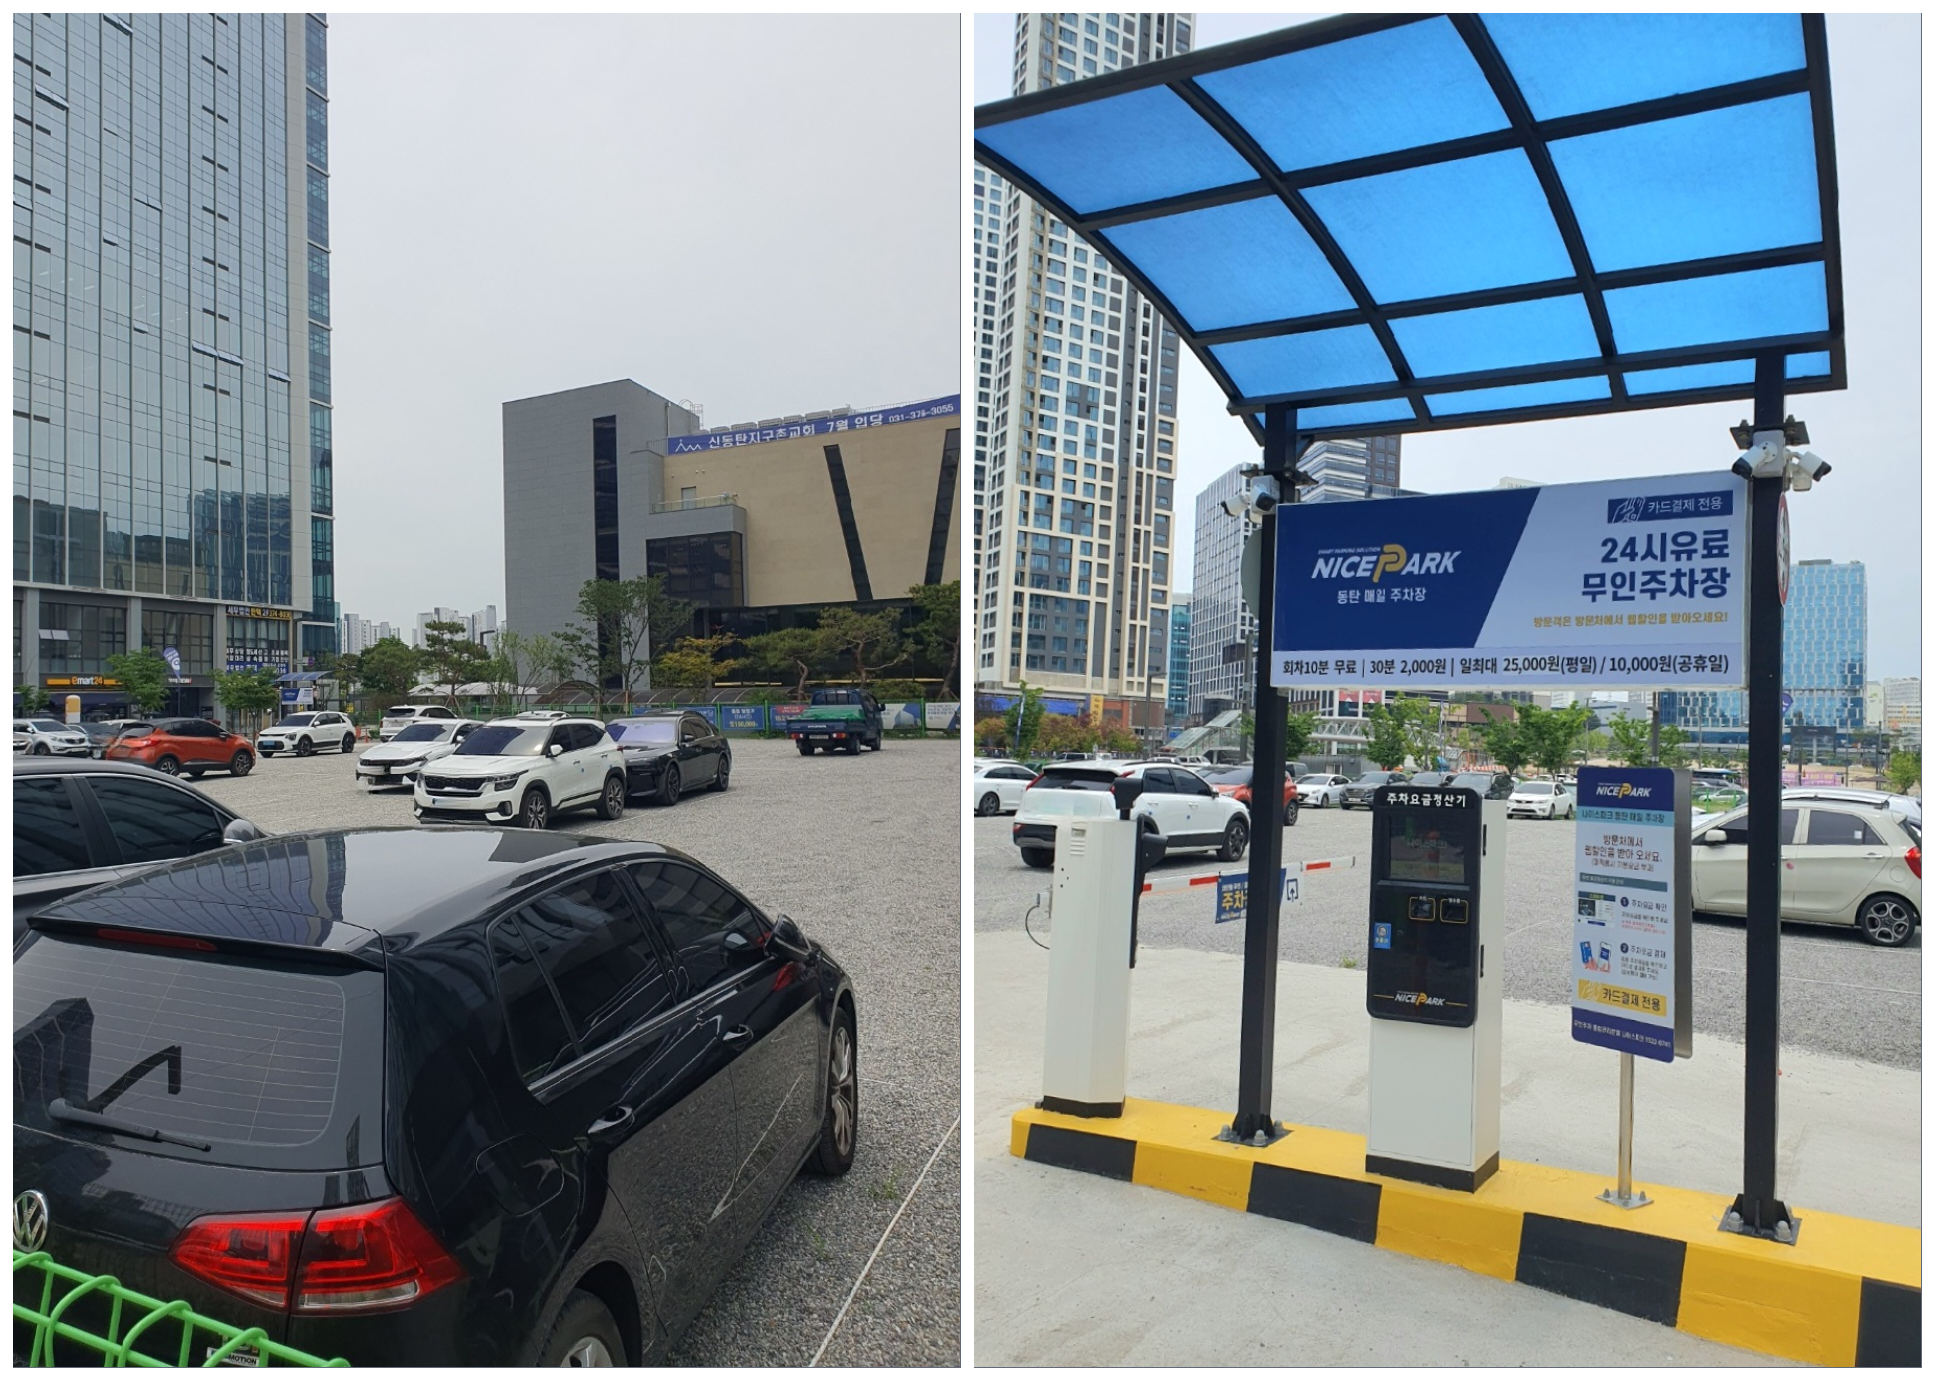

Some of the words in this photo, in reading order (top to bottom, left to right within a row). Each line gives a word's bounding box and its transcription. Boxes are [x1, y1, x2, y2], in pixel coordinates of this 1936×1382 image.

[709, 424, 815, 449] 신동탄지구촌교회
[828, 418, 849, 432] 7월
[1648, 498, 1694, 514] 카드결제
[1698, 497, 1722, 511] 전용
[1601, 529, 1729, 563] 24시유료
[1581, 566, 1731, 602] 무인주차장
[1337, 590, 1361, 604] 동탄
[1364, 588, 1386, 603] 매일
[1390, 587, 1426, 602] 주차장
[1575, 614, 1623, 626] 방문처에서
[1282, 659, 1329, 675] 회차10분
[1334, 659, 1357, 674] 무료
[1370, 659, 1395, 674] 30분
[1400, 658, 1446, 676] 2,000원
[1460, 657, 1497, 674] 일최대
[1503, 655, 1597, 674] 25,000원(평일)
[1609, 654, 1729, 674] 10,000원(공휴일)
[71, 676, 102, 685] emart24
[1596, 783, 1652, 798] NICEPARK
[1387, 792, 1466, 808] 주차요금정산기
[1603, 834, 1643, 848] 방문처에서
[1617, 848, 1633, 860] 받아
[1394, 992, 1445, 1006] NICEPARK
[1602, 988, 1639, 1007] 카드결제
[1641, 995, 1660, 1012] 전용
